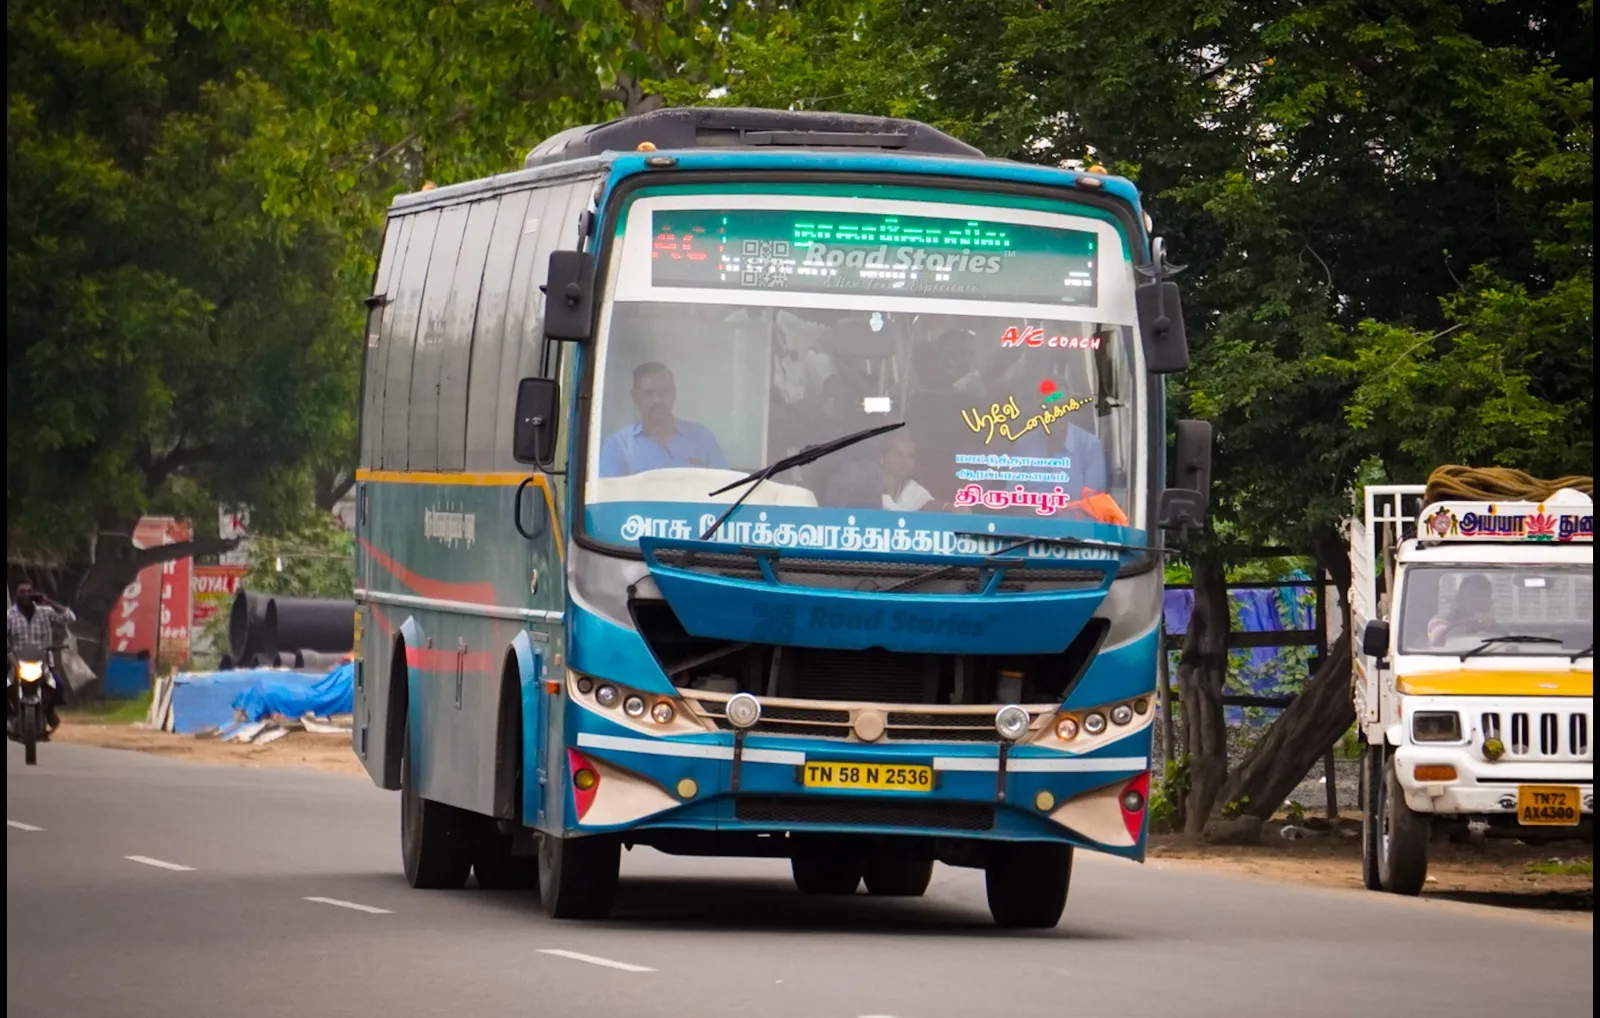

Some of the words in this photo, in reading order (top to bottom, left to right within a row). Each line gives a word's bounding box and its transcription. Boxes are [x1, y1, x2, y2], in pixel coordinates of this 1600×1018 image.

[1001, 325, 1045, 348] A/C
[1047, 336, 1101, 350] COACH
[954, 484, 1070, 516] திருப்பூர்
[620, 514, 693, 541] அரசு
[1459, 504, 1527, 535] அய்யா
[808, 766, 833, 782] TN
[839, 767, 860, 783] 58
[866, 767, 879, 783] N
[885, 768, 929, 785] 2536
[1524, 806, 1574, 819] AX4300
